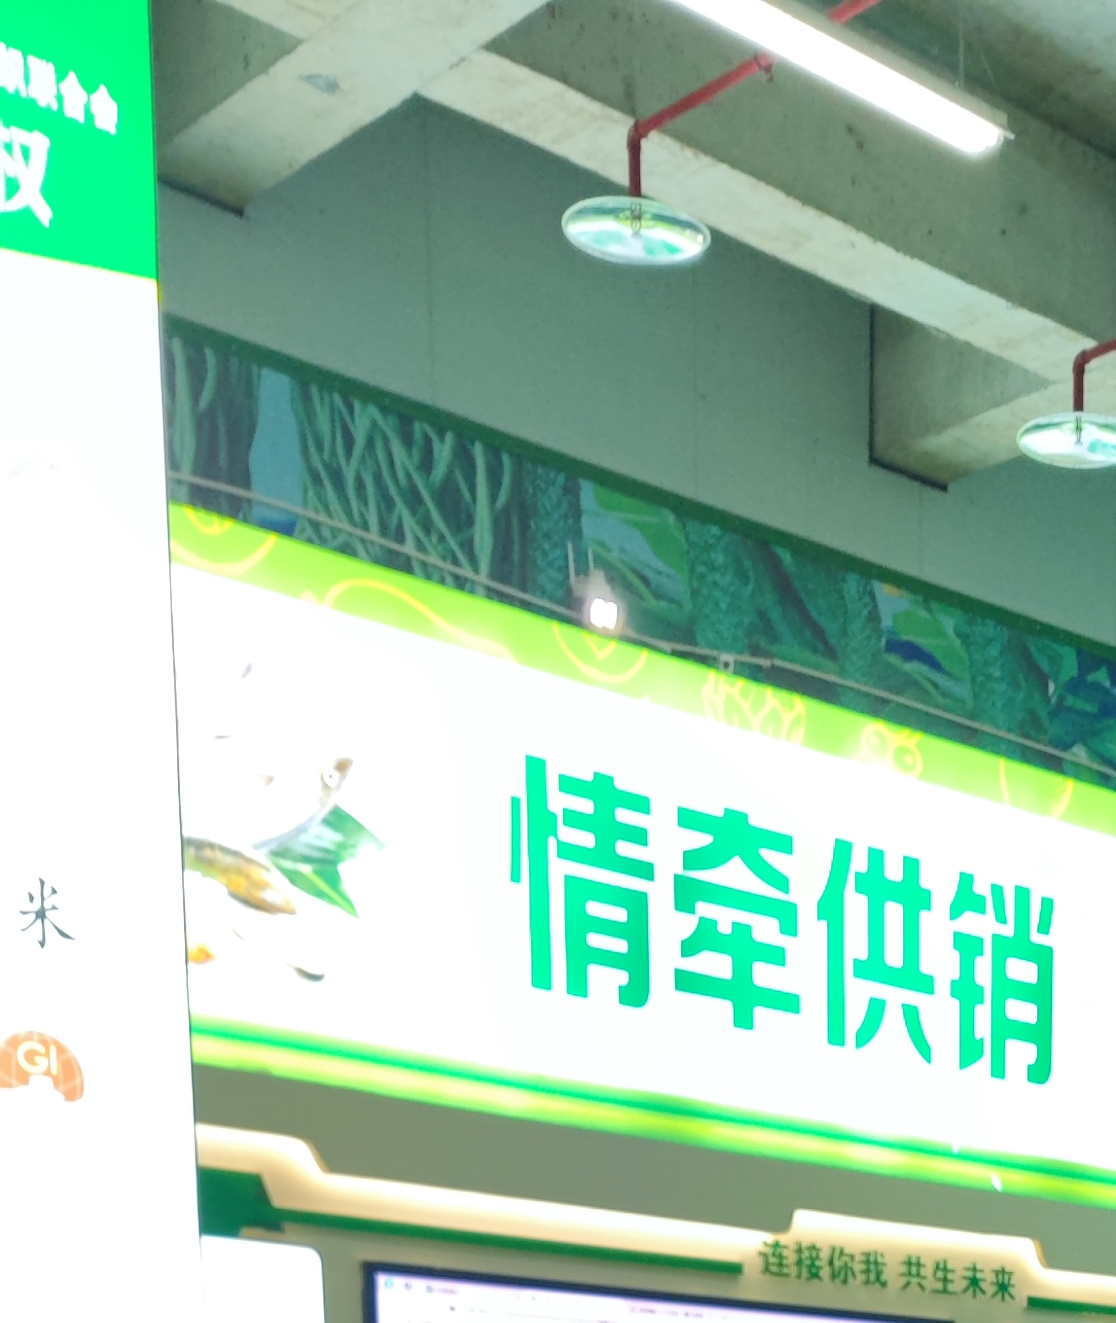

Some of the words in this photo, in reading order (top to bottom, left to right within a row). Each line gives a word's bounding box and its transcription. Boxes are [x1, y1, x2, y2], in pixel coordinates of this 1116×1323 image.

[19, 877, 76, 949] 米
[509, 753, 1055, 1086] 情牵供销
[16, 1039, 59, 1077] GI
[758, 1240, 889, 1290] 连接你我
[898, 1254, 1017, 1303] 共生未来
